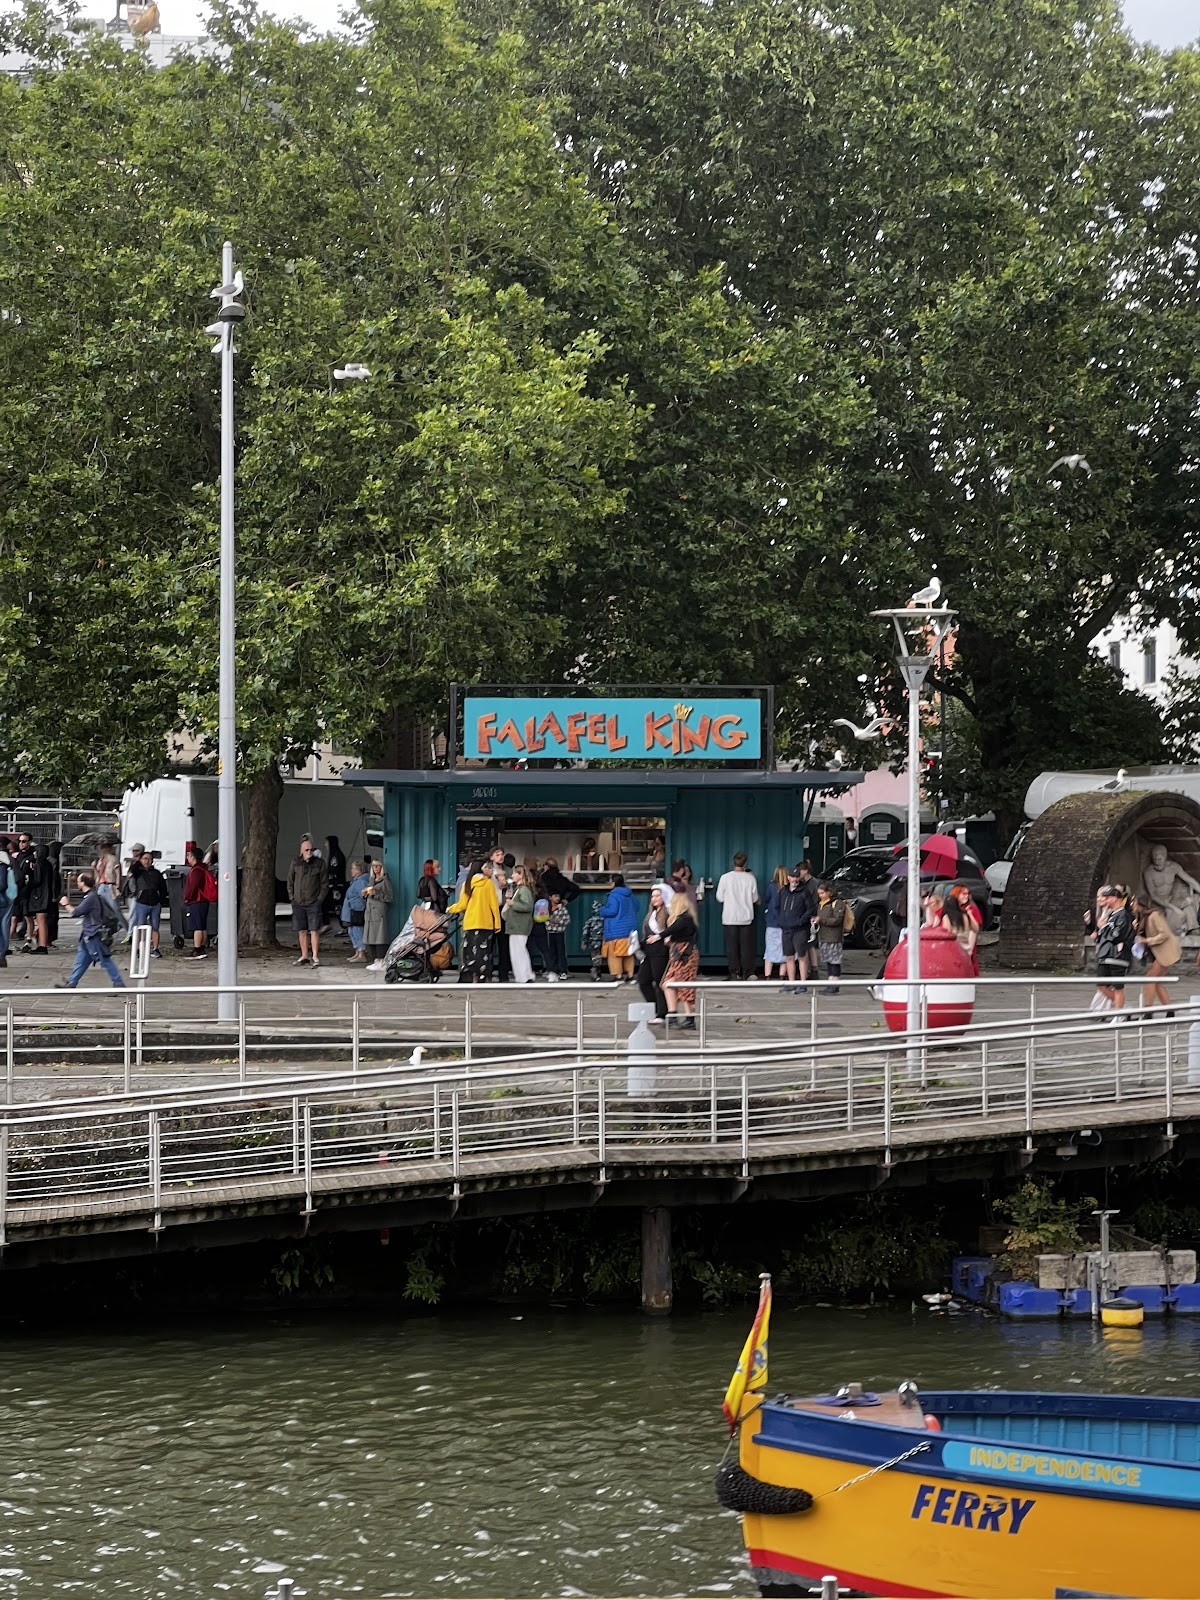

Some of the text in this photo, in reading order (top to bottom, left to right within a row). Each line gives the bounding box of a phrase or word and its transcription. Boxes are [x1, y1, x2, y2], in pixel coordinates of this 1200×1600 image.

[477, 711, 748, 755] FALAFEL KING
[969, 1447, 1142, 1487] INDEPENDENCE
[910, 1483, 1036, 1535] FERRY
